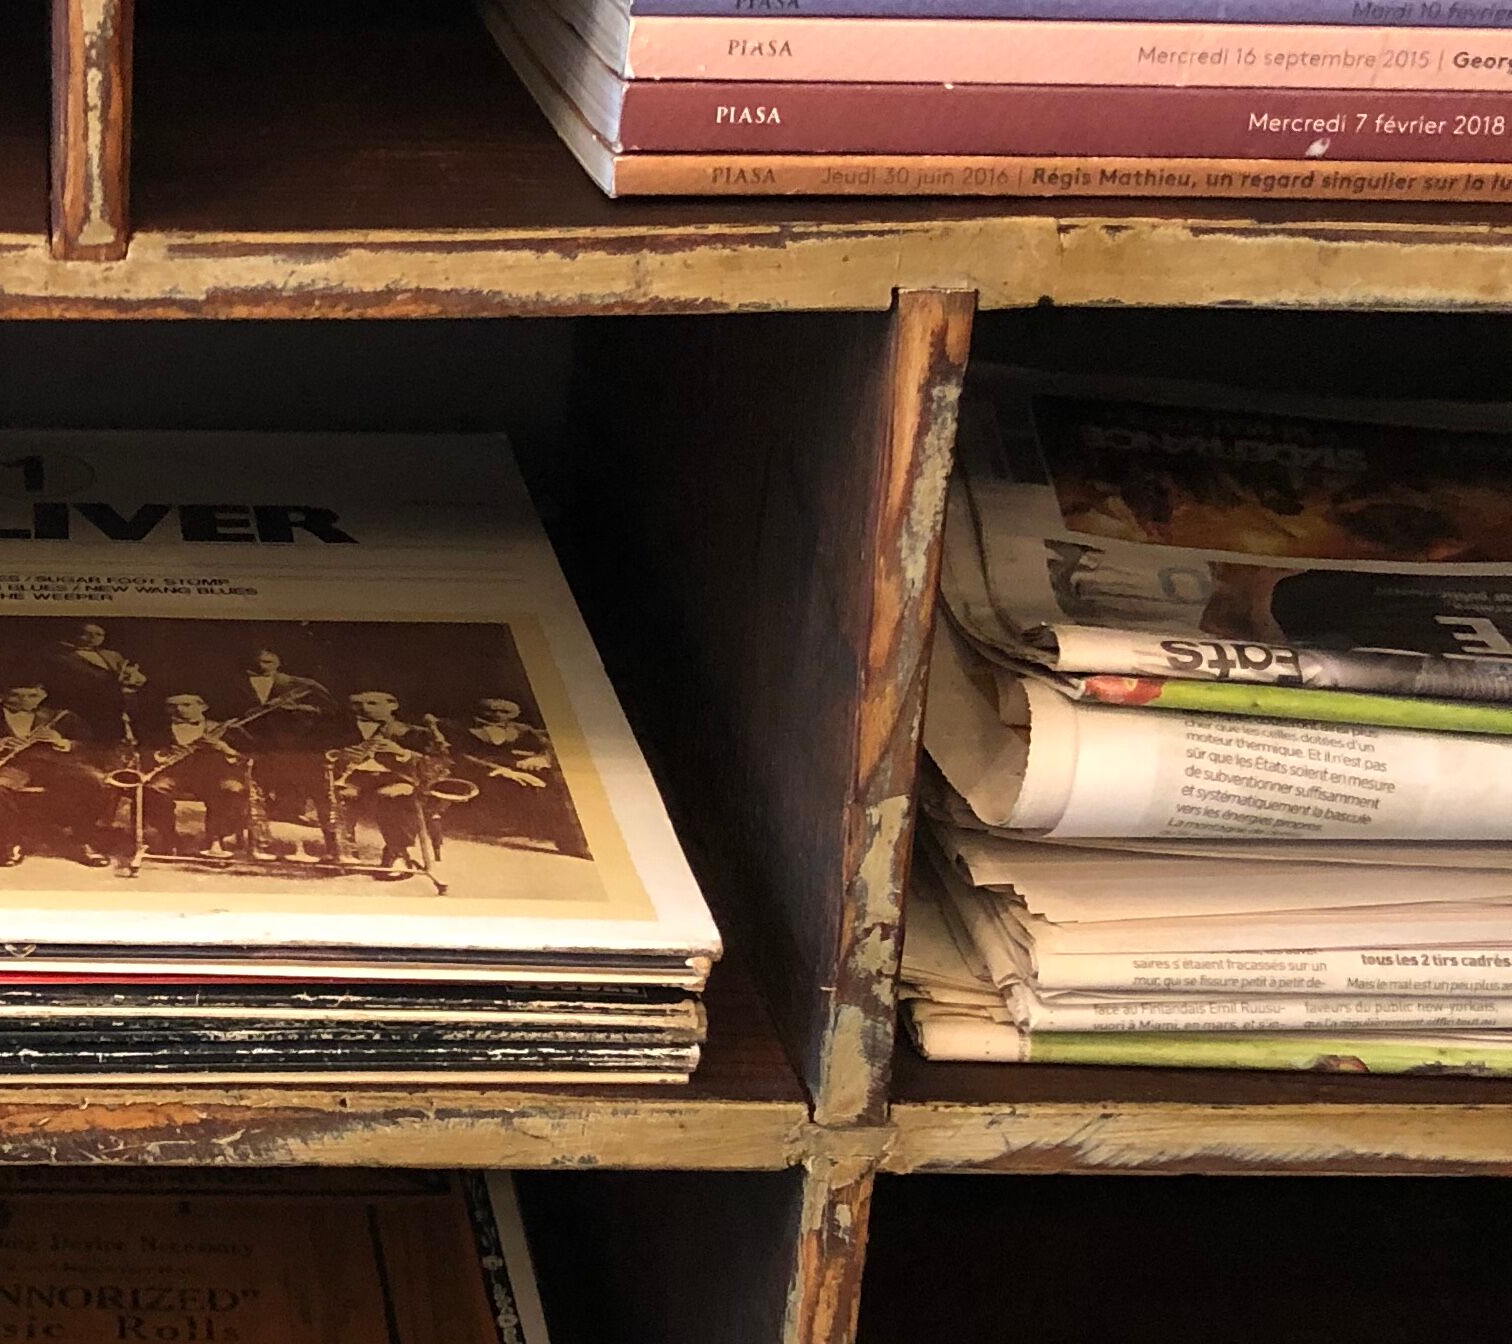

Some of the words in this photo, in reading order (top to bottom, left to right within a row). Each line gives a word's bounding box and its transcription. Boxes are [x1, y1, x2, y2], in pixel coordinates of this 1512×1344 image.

[1351, 1, 1413, 19] Mardi
[1419, 2, 1442, 19] 10
[727, 38, 794, 57] PIASA
[1137, 45, 1230, 65] Mercredi
[1236, 47, 1256, 66] 16
[1263, 46, 1377, 71] septembre
[1380, 49, 1430, 70] 2015
[714, 105, 783, 125] PIASA
[1247, 112, 1346, 134] Mercredi
[1355, 113, 1368, 133] 7
[1373, 112, 1447, 135] février
[1452, 114, 1506, 136] 2018
[711, 167, 777, 186] PIASA
[820, 167, 877, 187] Jeudi
[883, 168, 910, 187] 30
[913, 168, 955, 191] juin
[962, 168, 1011, 188] 2016
[1031, 166, 1093, 191] Régis
[1098, 168, 1197, 191] Mathieu,
[1205, 173, 1234, 188] un
[1239, 170, 1316, 194] regard
[1320, 170, 1418, 196] singulier
[1423, 174, 1458, 191] sur
[1464, 172, 1485, 190] la
[1185, 732, 1233, 747] moteur
[1307, 747, 1322, 762] Et
[1364, 759, 1389, 773] pas
[1185, 746, 1207, 760] sûr
[1207, 751, 1234, 765] que
[1234, 753, 1254, 769] les
[1254, 754, 1289, 775] États
[1289, 764, 1329, 782] soient
[1329, 771, 1347, 784] en
[1347, 774, 1397, 794] mesure
[1180, 784, 1196, 797] et
[1195, 787, 1312, 816] systématiquement
[1183, 763, 1203, 779] de
[1203, 768, 1294, 795] subventionner
[1294, 784, 1382, 810] suffisamment
[1175, 802, 1202, 816] vers
[1131, 958, 1171, 970] saires
[1311, 961, 1328, 973] un
[1360, 953, 1394, 967] tous
[1395, 953, 1419, 967] les
[1419, 954, 1430, 967] 2
[1432, 954, 1459, 968] tirs
[1346, 976, 1376, 990] Mais
[115, 1313, 241, 1343] Rolls
